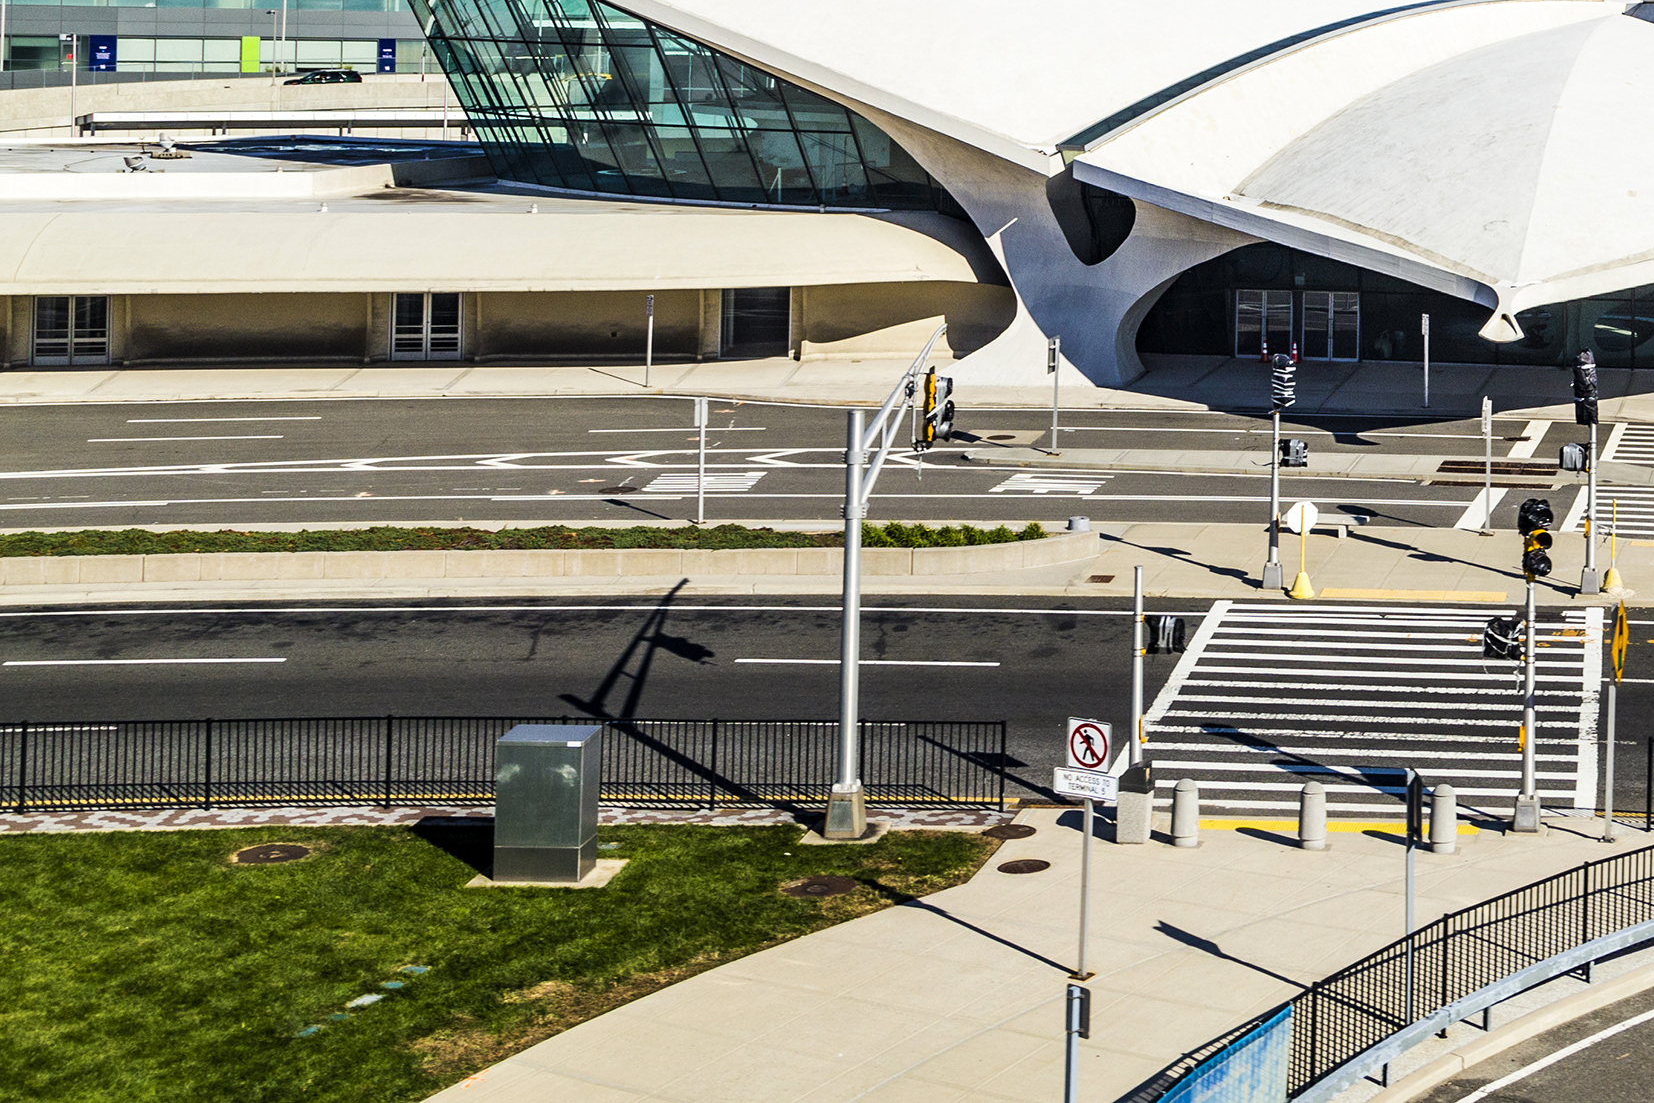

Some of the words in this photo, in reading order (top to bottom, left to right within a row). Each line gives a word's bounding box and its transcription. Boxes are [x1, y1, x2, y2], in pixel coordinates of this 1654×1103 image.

[988, 473, 1114, 495] LANE
[1075, 775, 1100, 786] ACCESS
[1102, 778, 1110, 787] TO
[1068, 782, 1099, 794] TERMINAL
[1101, 787, 1106, 796] 5
